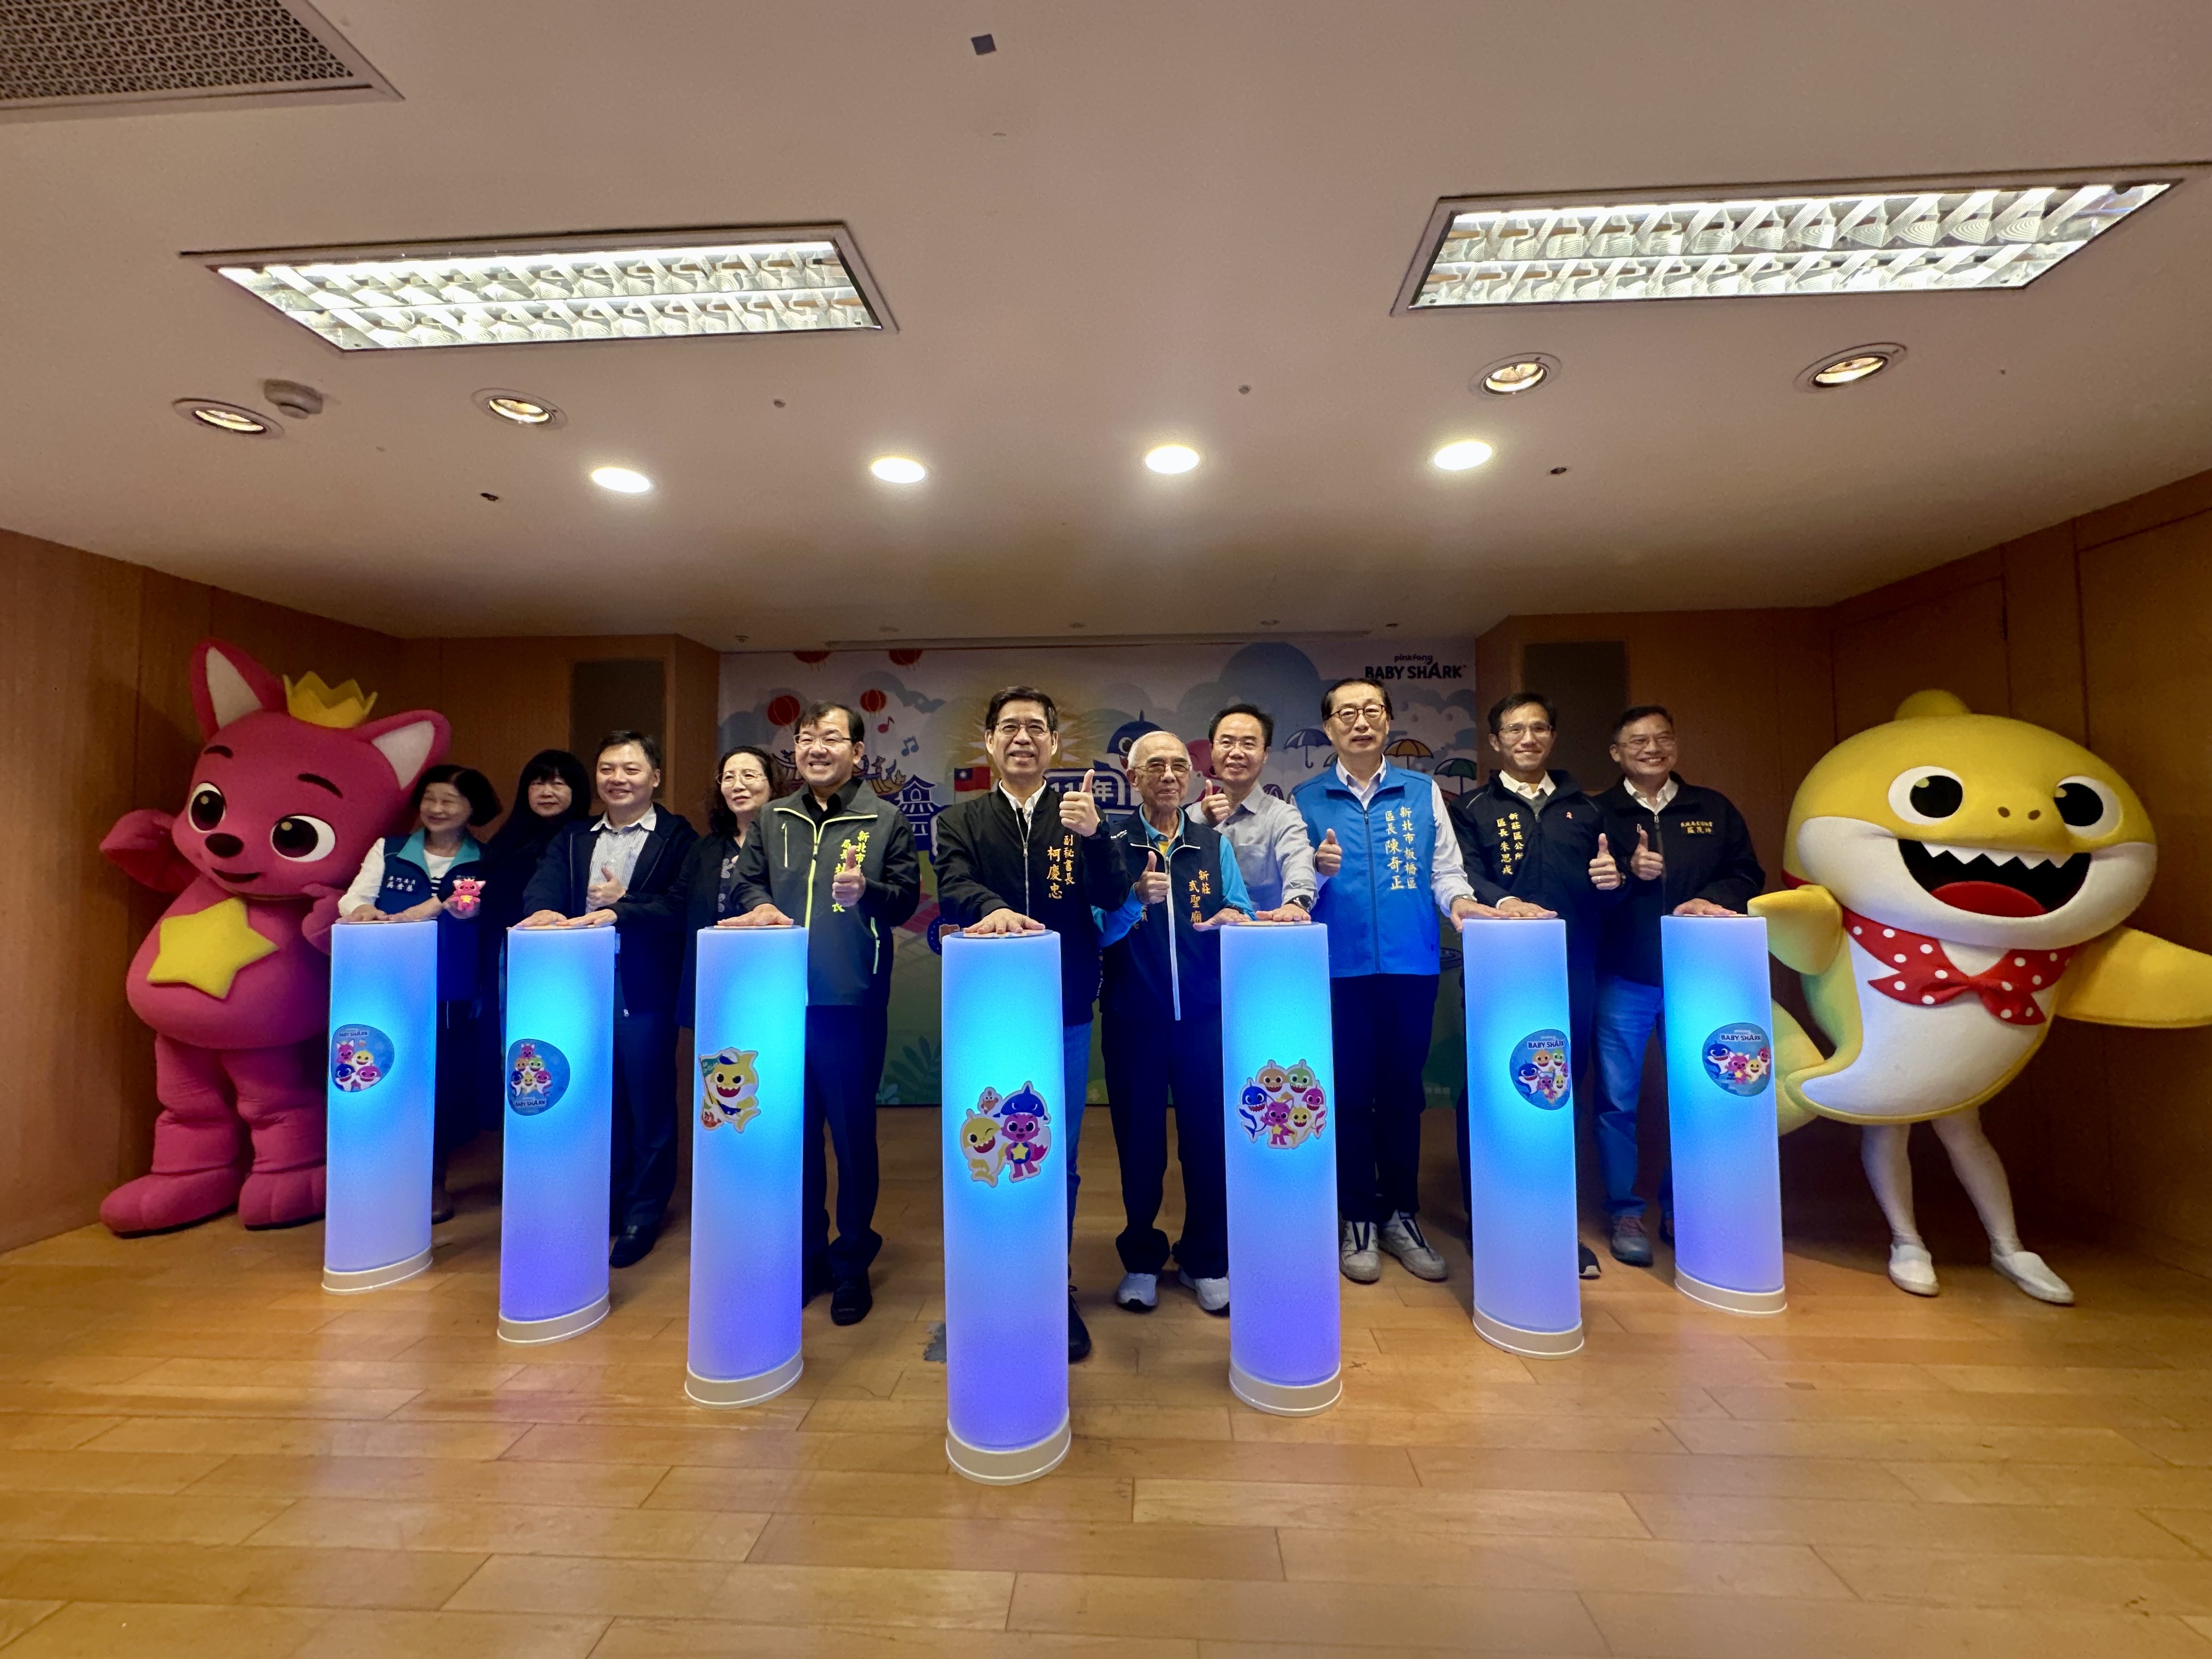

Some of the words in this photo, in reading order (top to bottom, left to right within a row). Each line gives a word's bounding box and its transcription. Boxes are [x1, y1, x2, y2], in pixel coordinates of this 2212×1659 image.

[1365, 665, 1404, 680] BABY
[1407, 662, 1463, 679] SHARK
[1394, 653, 1434, 665] pinkfong
[1385, 810, 1397, 835] 區長
[1509, 812, 1524, 861] 新莊區公所
[1063, 834, 1075, 885] 副秘書長
[1400, 806, 1418, 889] 新北市板橋區
[1046, 845, 1063, 899] 柯慶忠
[1198, 870, 1211, 894] 新莊
[1188, 879, 1202, 923] 武聖廟
